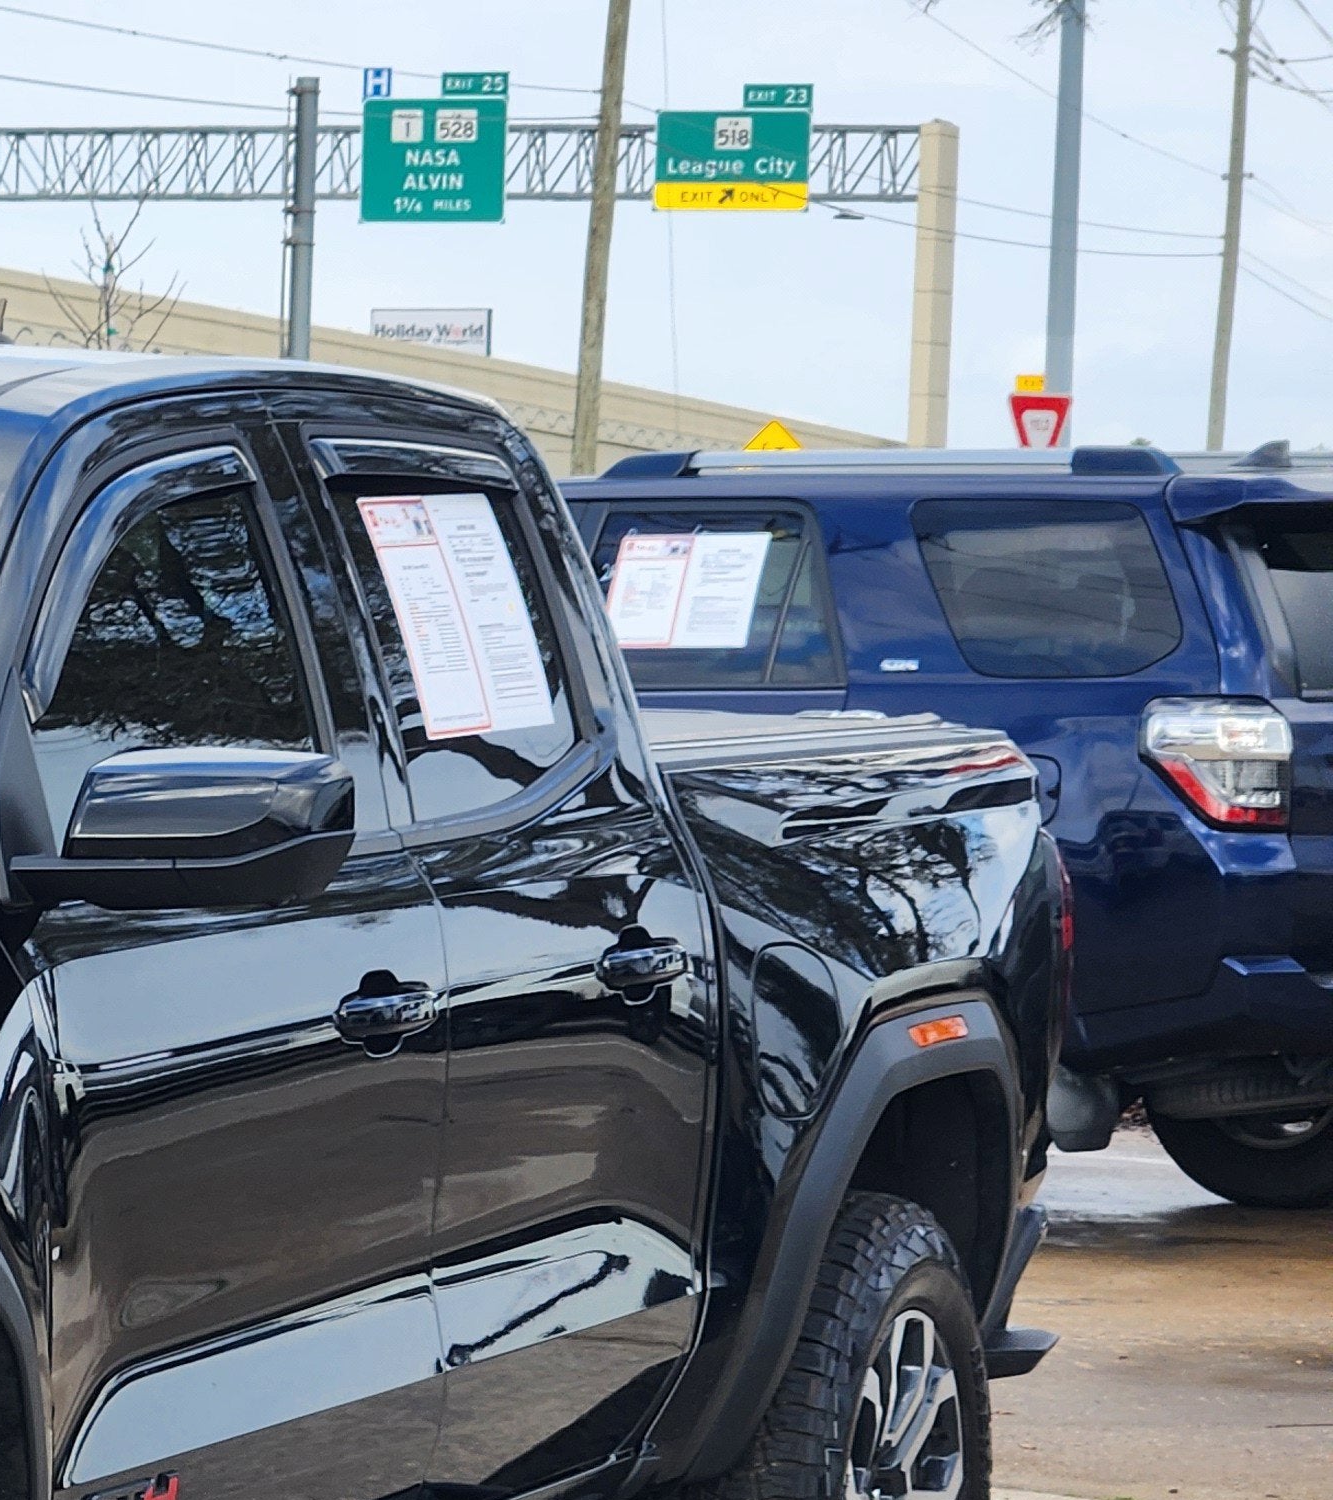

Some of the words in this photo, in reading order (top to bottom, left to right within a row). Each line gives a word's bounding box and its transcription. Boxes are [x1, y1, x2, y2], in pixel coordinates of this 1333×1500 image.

[445, 78, 474, 91] EXIT
[481, 75, 505, 92] 25
[748, 89, 777, 102] EXIT
[784, 88, 808, 104] 23
[439, 121, 474, 139] 528
[717, 128, 749, 147] 518
[404, 149, 461, 167] NASA
[666, 157, 745, 180] League
[754, 156, 796, 179] City
[402, 172, 464, 191] ALVIN
[433, 199, 471, 212] MILES
[681, 191, 713, 204] EXIT
[740, 191, 781, 203] ONLY
[374, 323, 433, 342] Holiday
[435, 323, 484, 338] World
